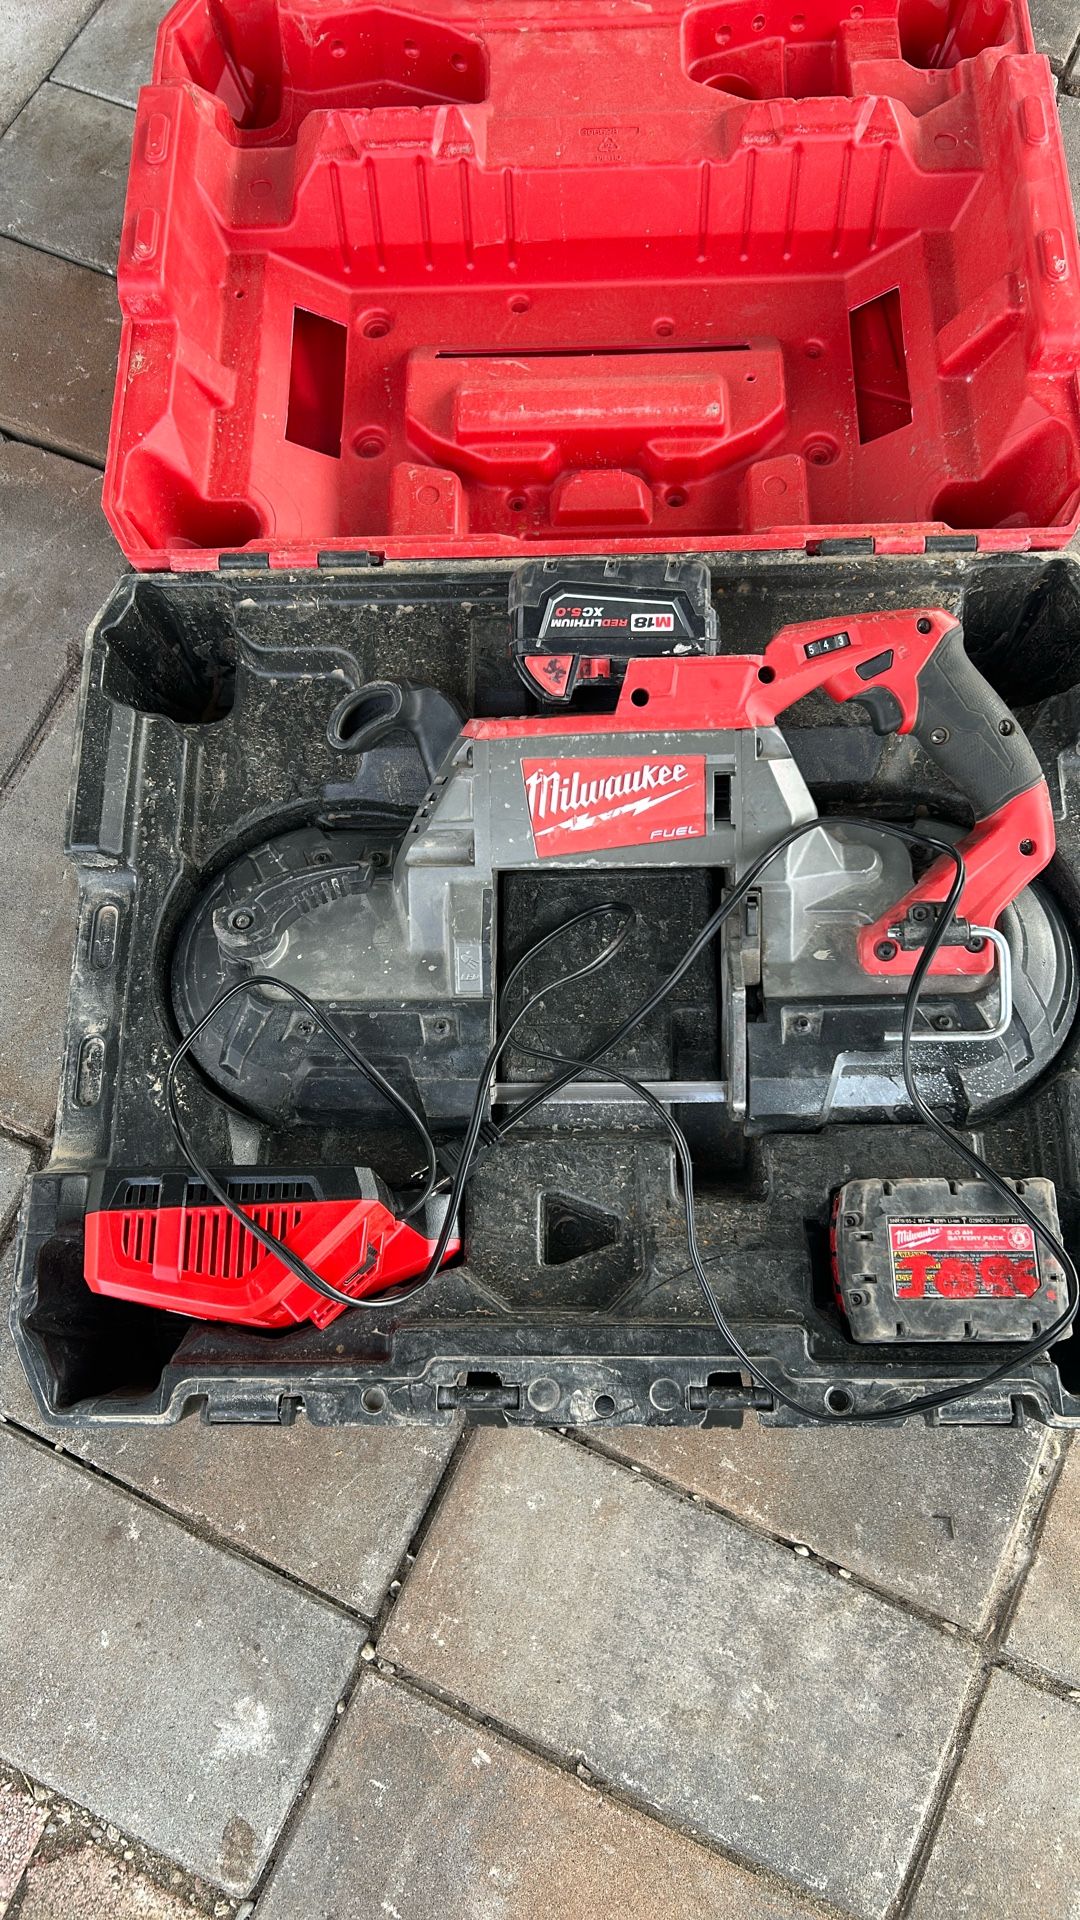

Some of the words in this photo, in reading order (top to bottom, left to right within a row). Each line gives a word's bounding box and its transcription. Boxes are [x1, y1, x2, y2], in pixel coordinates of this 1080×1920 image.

[555, 607, 604, 617] XC5.0
[550, 618, 629, 628] REDLITHIUM
[634, 616, 671, 629] M18
[808, 645, 815, 655] 5
[823, 640, 829, 650] 4
[837, 636, 844, 646] 3
[525, 763, 689, 819] Milwaukee
[650, 825, 699, 840] FUEL
[894, 1227, 942, 1245] Milwaukee
